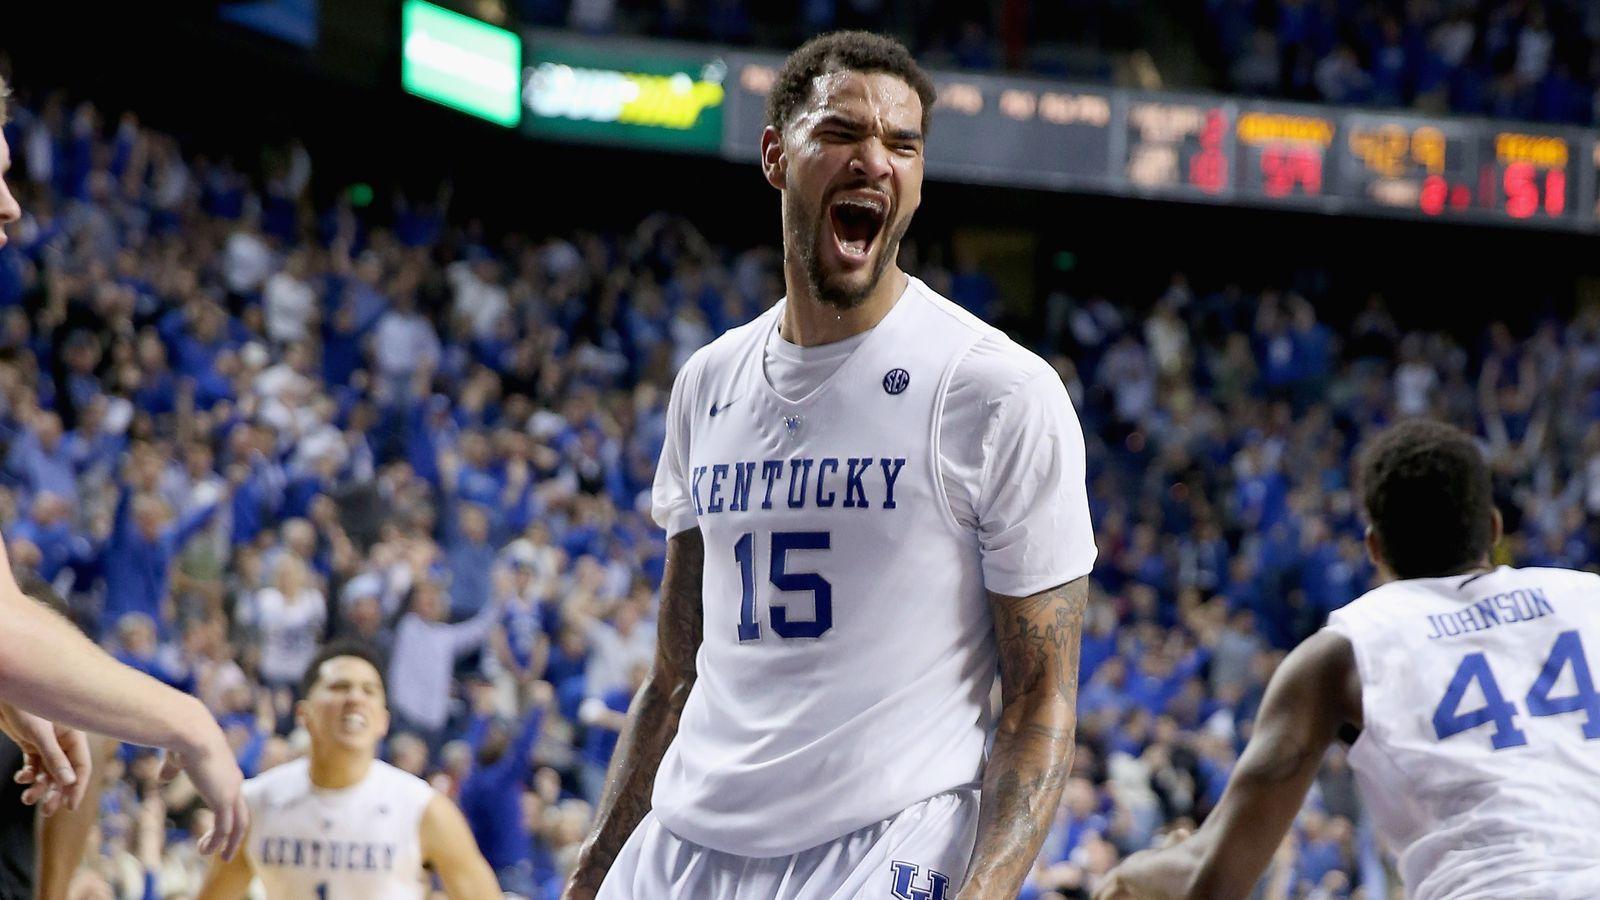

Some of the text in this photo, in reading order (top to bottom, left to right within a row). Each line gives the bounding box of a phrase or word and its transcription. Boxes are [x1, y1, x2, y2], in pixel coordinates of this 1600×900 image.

[1503, 161, 1567, 219] 51
[884, 369, 909, 394] SEC
[692, 458, 906, 515] KENTUCKY
[735, 531, 833, 642] 15
[1427, 588, 1555, 640] JOHNSON
[1433, 630, 1600, 750] 44
[261, 837, 395, 870] KENTUCKY
